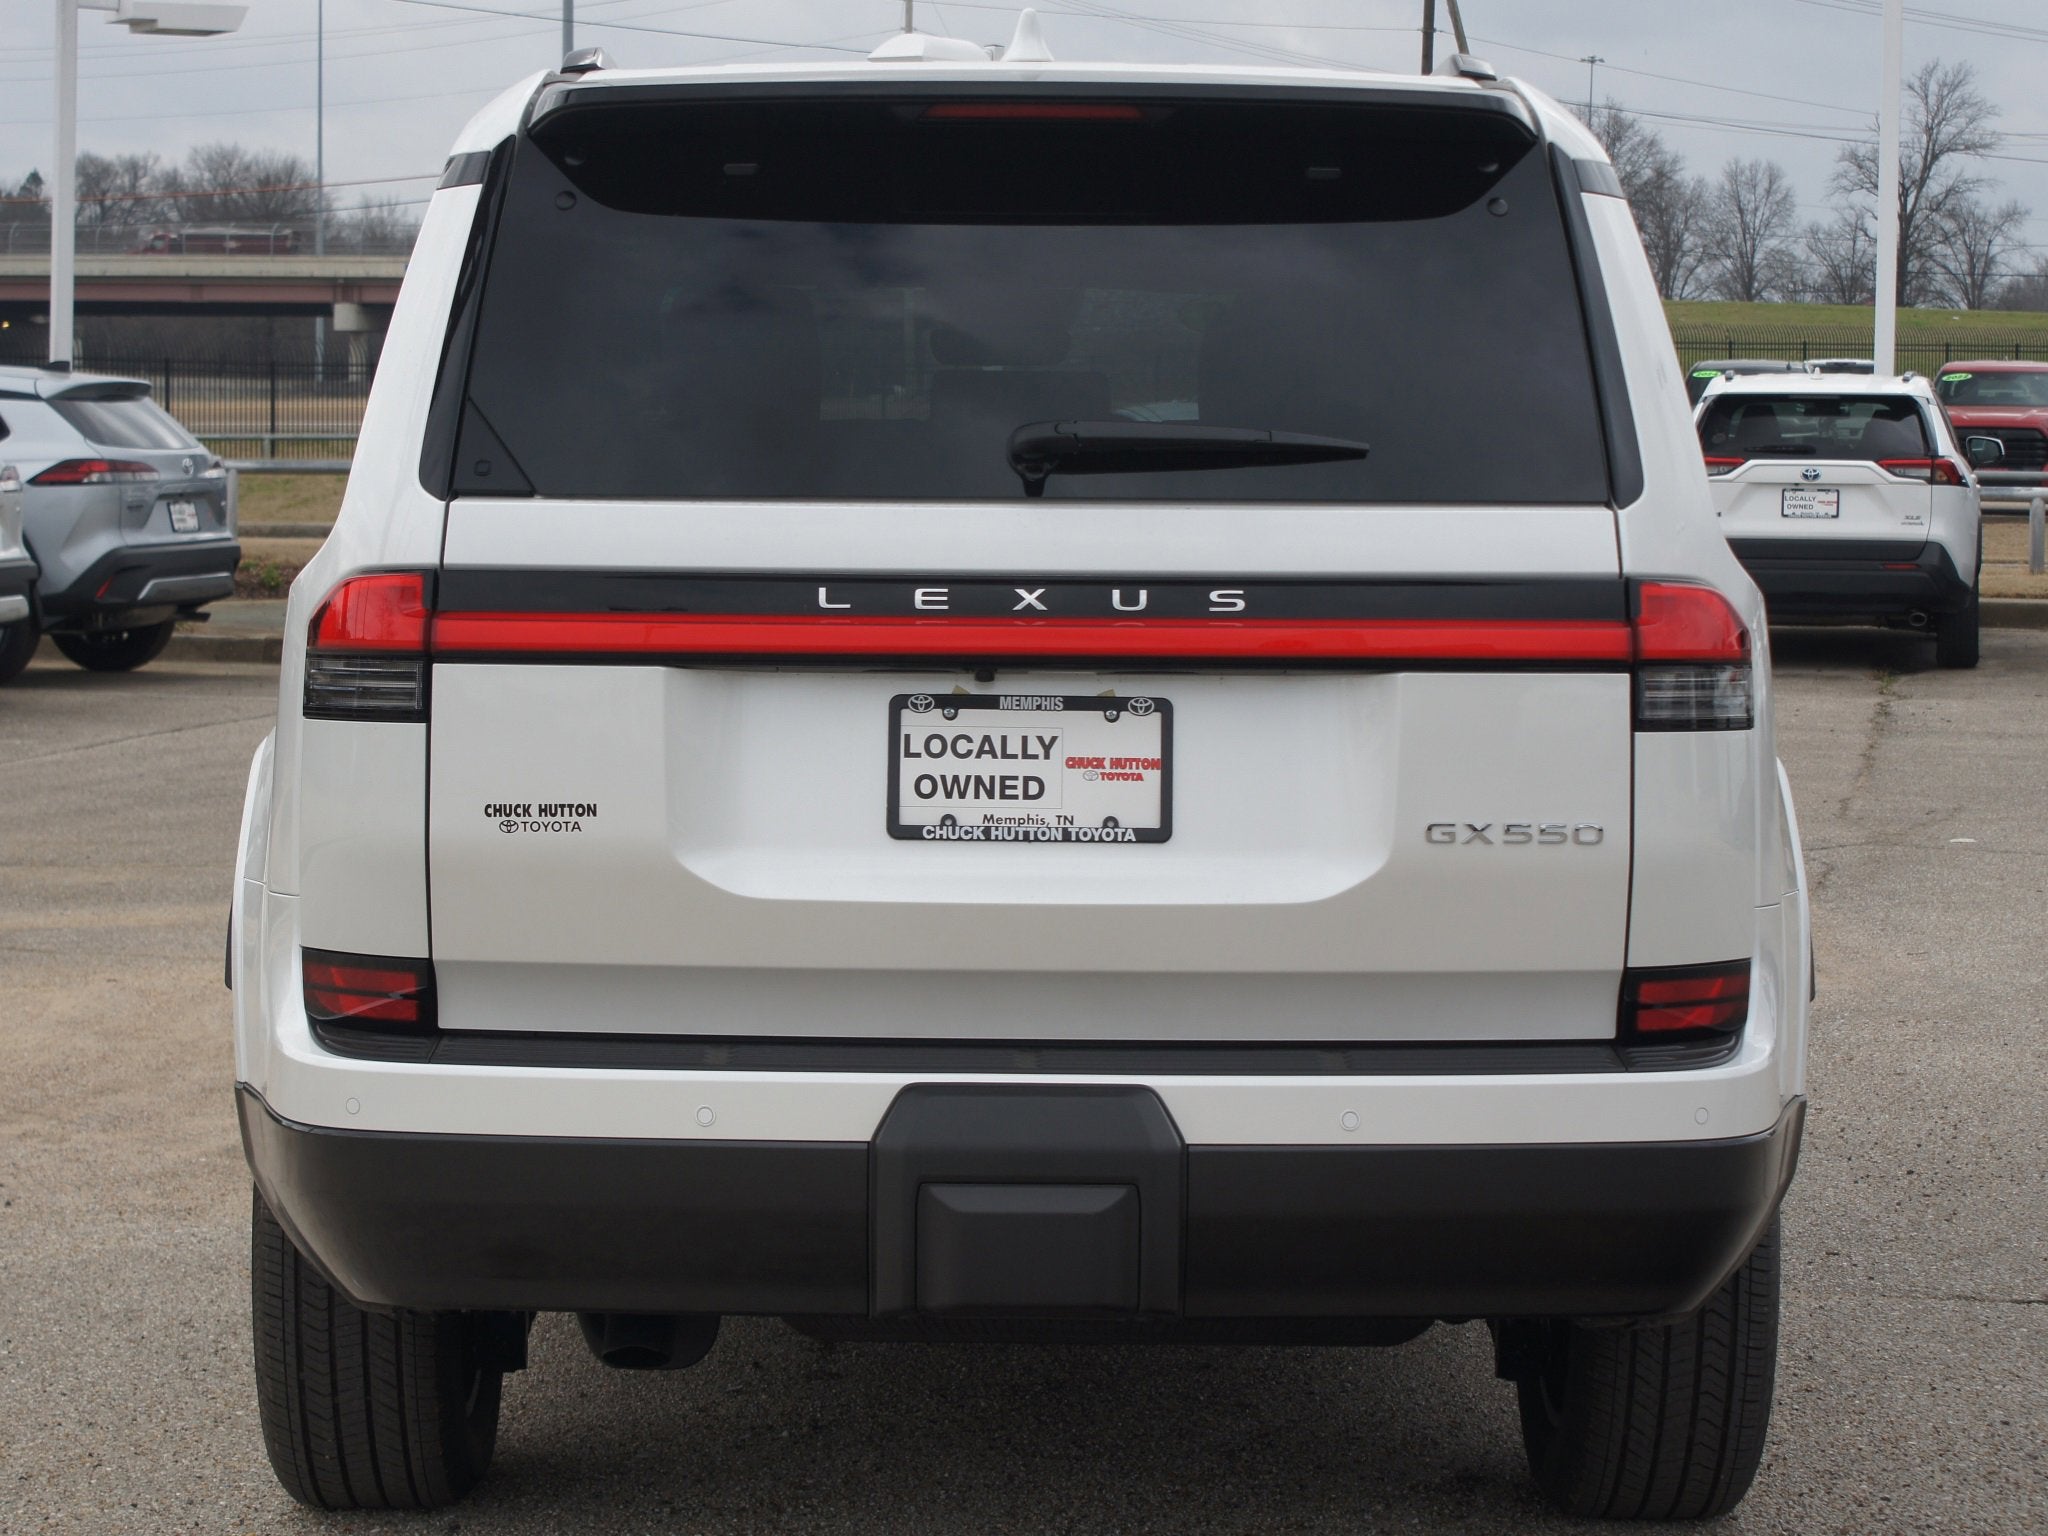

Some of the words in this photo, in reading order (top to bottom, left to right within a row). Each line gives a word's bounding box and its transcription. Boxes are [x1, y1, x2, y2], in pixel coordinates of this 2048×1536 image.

[818, 586, 1246, 611] LEXUS
[999, 696, 1064, 711] MEMPHIS
[903, 733, 1059, 760] LOCALLY
[1065, 756, 1106, 770] CHUCK
[1110, 757, 1162, 770] HUTTON
[1100, 772, 1144, 781] TOYOTA
[914, 774, 1045, 800] OWNED
[484, 803, 532, 817] CHUCK
[538, 803, 597, 817] HUTTON
[520, 821, 582, 833] TOYOTA
[982, 813, 1050, 827] Memphis,
[1056, 814, 1075, 826] TN
[922, 826, 986, 840] CHUCK
[991, 827, 1063, 841] HUTTON
[1068, 827, 1136, 842] TOYOTA
